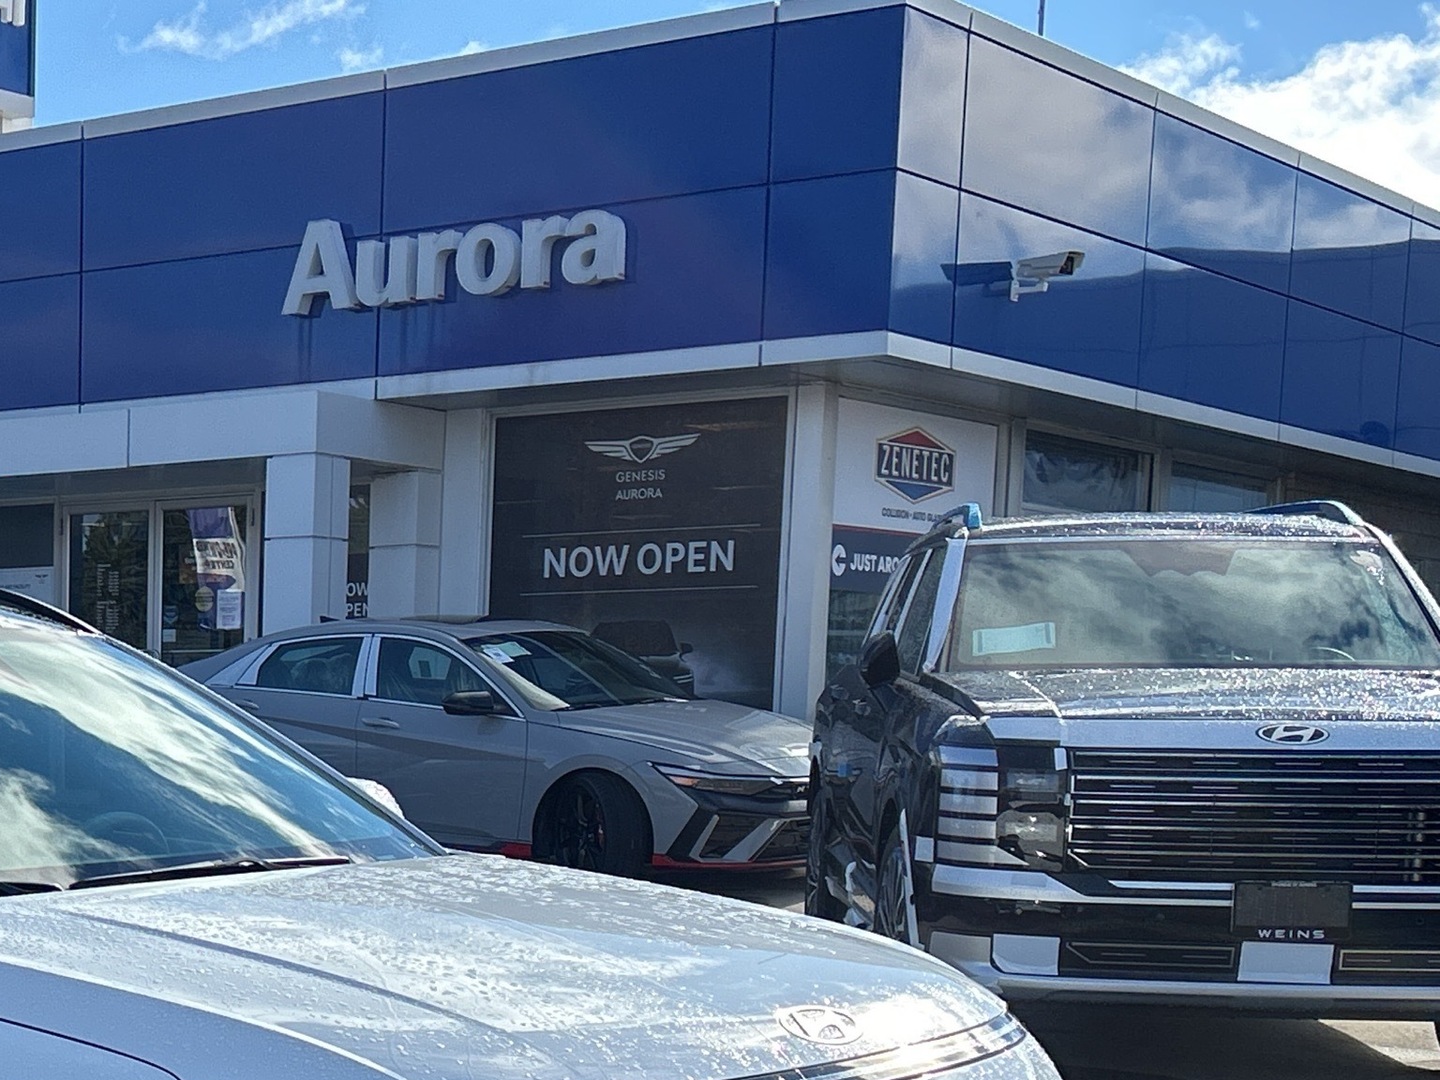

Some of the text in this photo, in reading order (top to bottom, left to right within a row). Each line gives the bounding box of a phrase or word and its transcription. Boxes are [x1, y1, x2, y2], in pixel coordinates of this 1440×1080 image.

[281, 209, 627, 316] Aurora
[880, 444, 950, 483] ZENETEC
[615, 469, 666, 483] GENESIS
[615, 487, 663, 500] AURORA
[543, 539, 735, 579] NOW OPEN
[849, 552, 877, 572] JUST
[1258, 929, 1325, 939] WEINS
